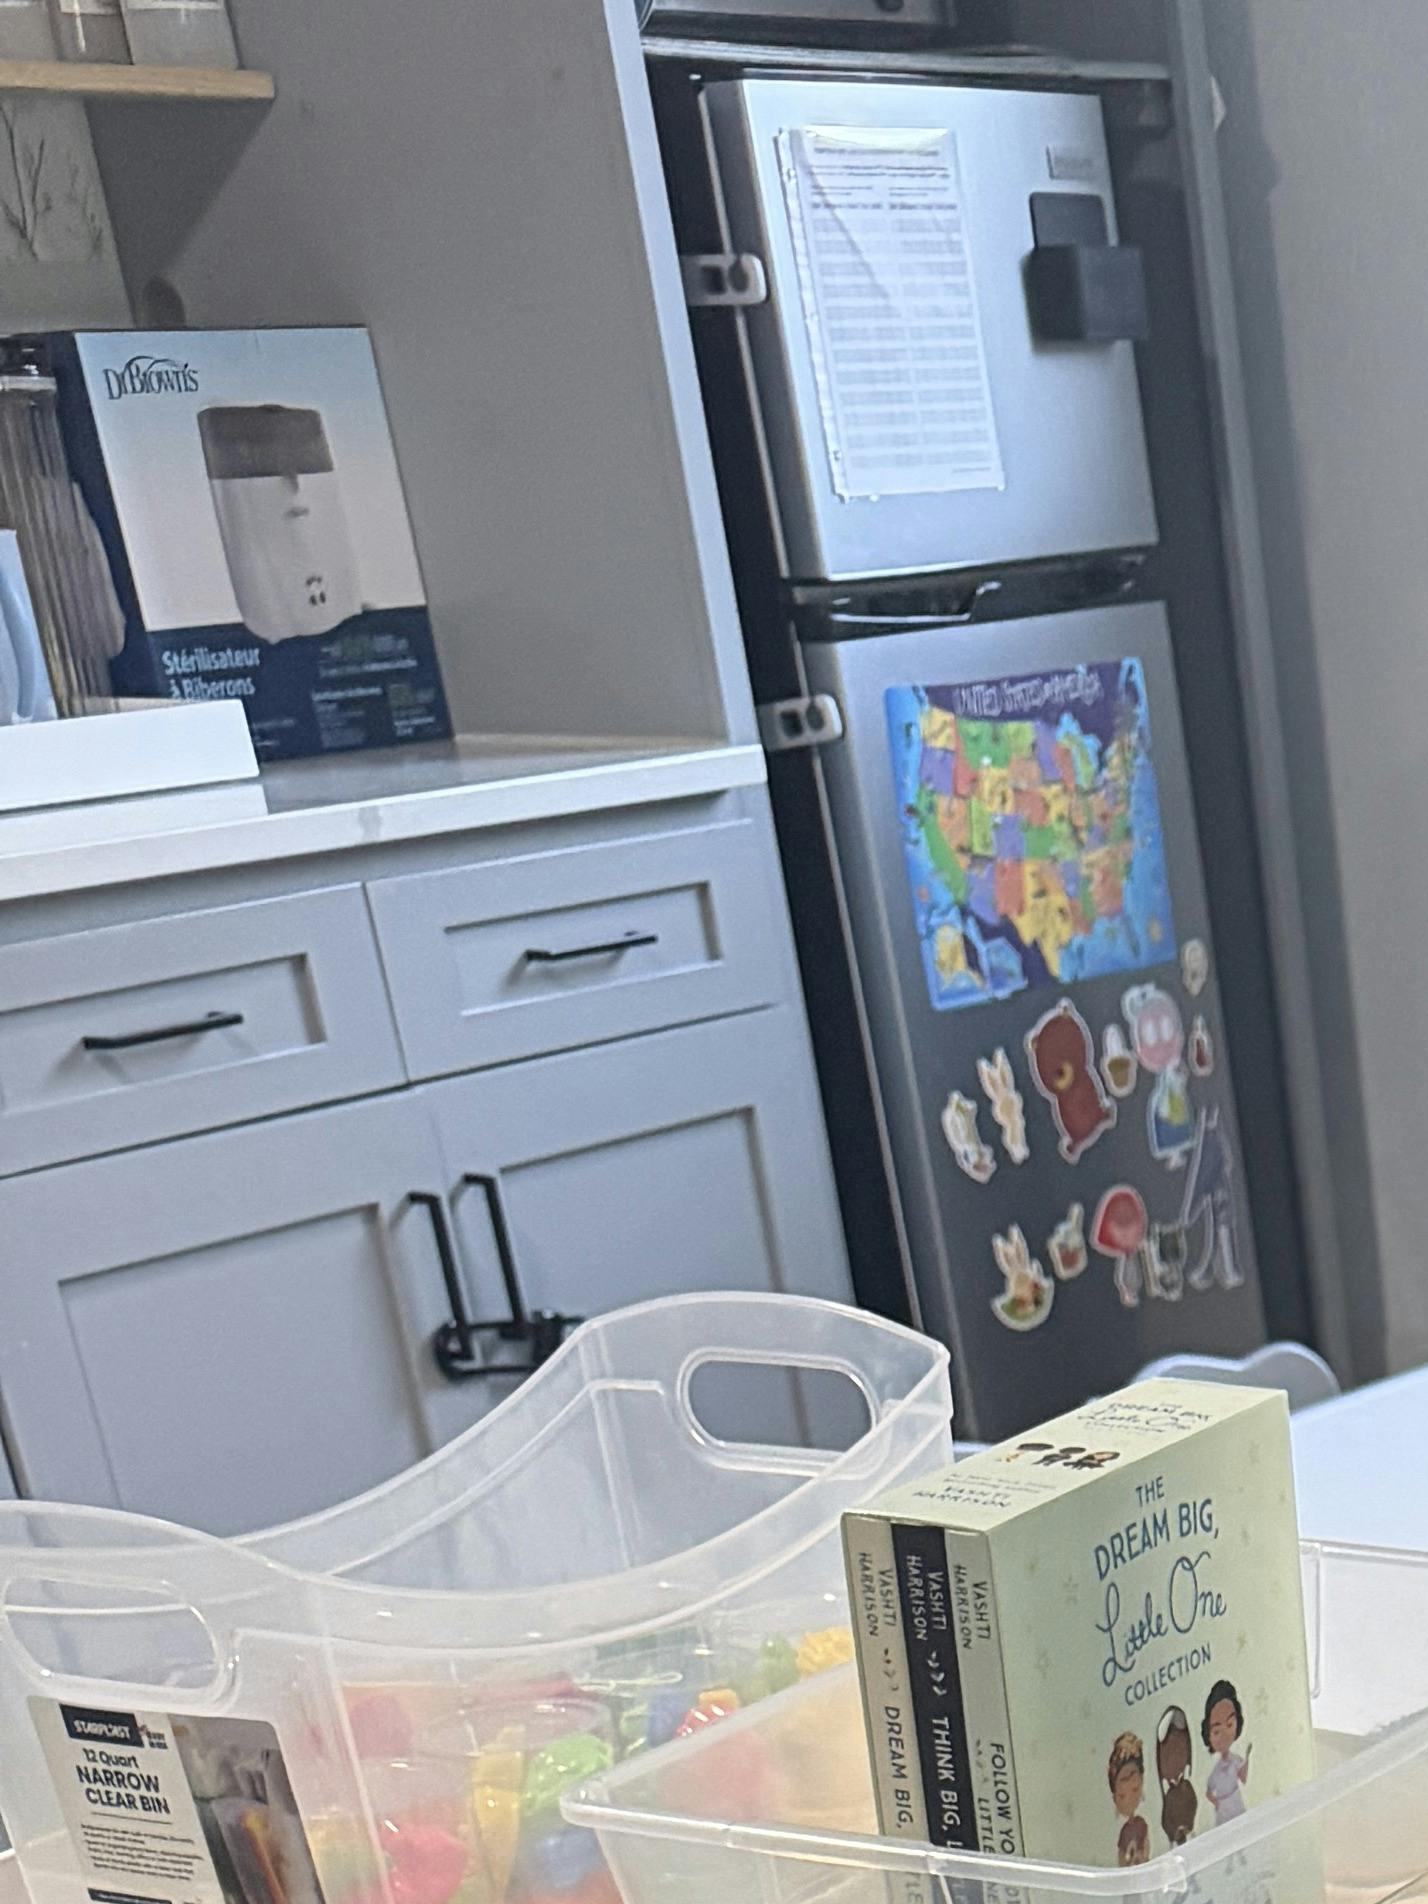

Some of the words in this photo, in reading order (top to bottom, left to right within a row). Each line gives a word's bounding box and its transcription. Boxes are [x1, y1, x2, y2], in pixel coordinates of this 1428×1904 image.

[161, 647, 261, 675] Stérilisateur
[953, 684, 1002, 717] UNITED
[1135, 1475, 1165, 1508] THE
[1094, 1508, 1171, 1581] DREAM
[1178, 1498, 1219, 1540] BIG,
[858, 1551, 879, 1637] HARRISON
[877, 1567, 897, 1627] VASHTI
[906, 1553, 929, 1641] HARRISON
[926, 1570, 948, 1631] VASHTI
[953, 1564, 972, 1650] HARRISON
[972, 1580, 992, 1640] VASHTI
[1095, 1582, 1169, 1687] Little
[1169, 1550, 1228, 1635] One
[1124, 1642, 1212, 1706] COLLECTION
[82, 1747, 98, 1763] 12
[99, 1749, 139, 1769] Quart
[884, 1705, 909, 1780] DREAM
[931, 1715, 956, 1782] THINK
[76, 1765, 160, 1794] NARROW
[85, 1787, 138, 1811] CLEAR
[139, 1796, 171, 1815] BIN
[895, 1788, 914, 1830] BIG,
[989, 1742, 1012, 1820] FOLLOW
[940, 1788, 961, 1832] BIG,
[977, 1798, 996, 1854] LITTLE
